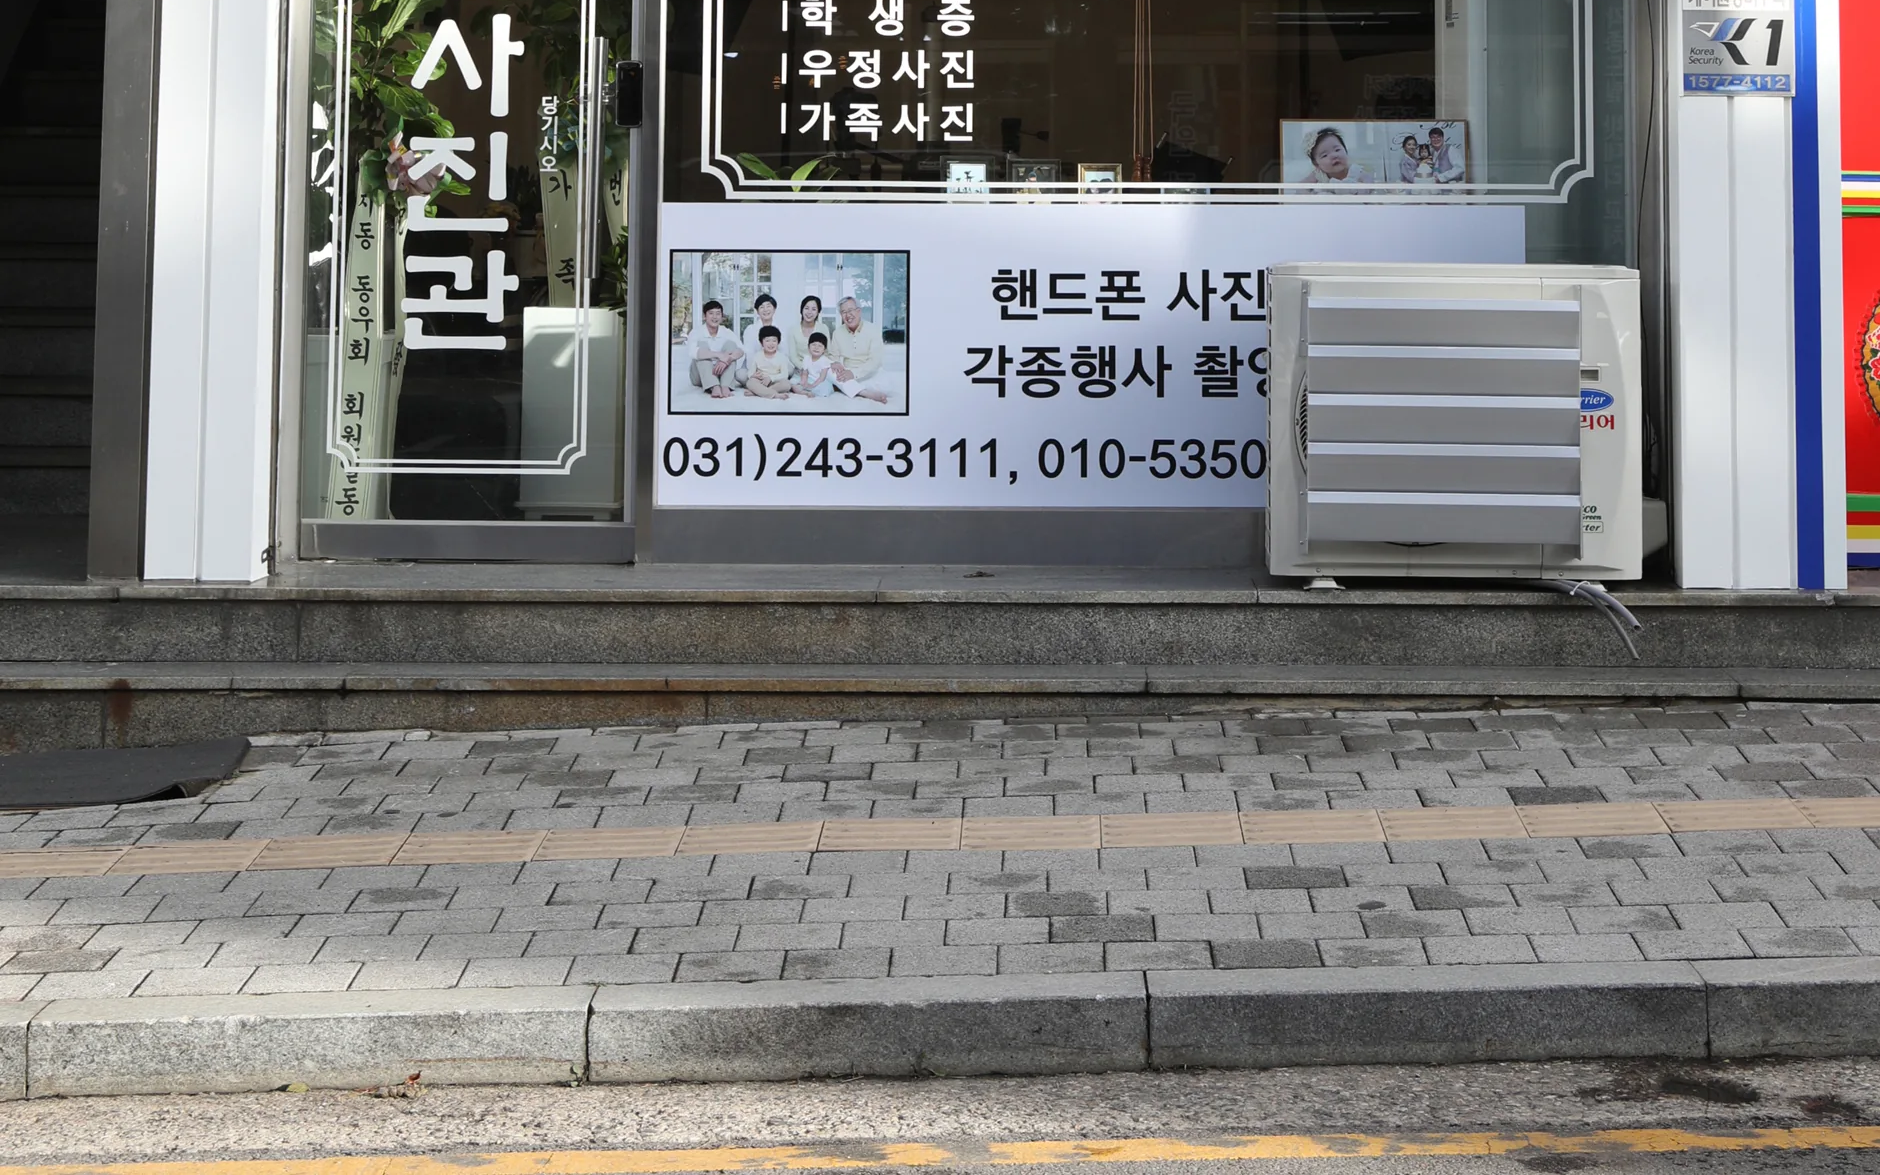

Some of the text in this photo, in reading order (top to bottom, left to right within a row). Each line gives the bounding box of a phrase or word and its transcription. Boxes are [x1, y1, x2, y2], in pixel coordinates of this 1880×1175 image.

[1688, 56, 1724, 66] Security
[1689, 47, 1715, 56] Korea
[1689, 75, 1787, 89] 1577-4112
[540, 95, 560, 173] 당기시오
[992, 269, 1266, 321] 핸드폰 사진
[964, 346, 1172, 398] 각종행사
[664, 434, 1017, 484] 031)243-3111,
